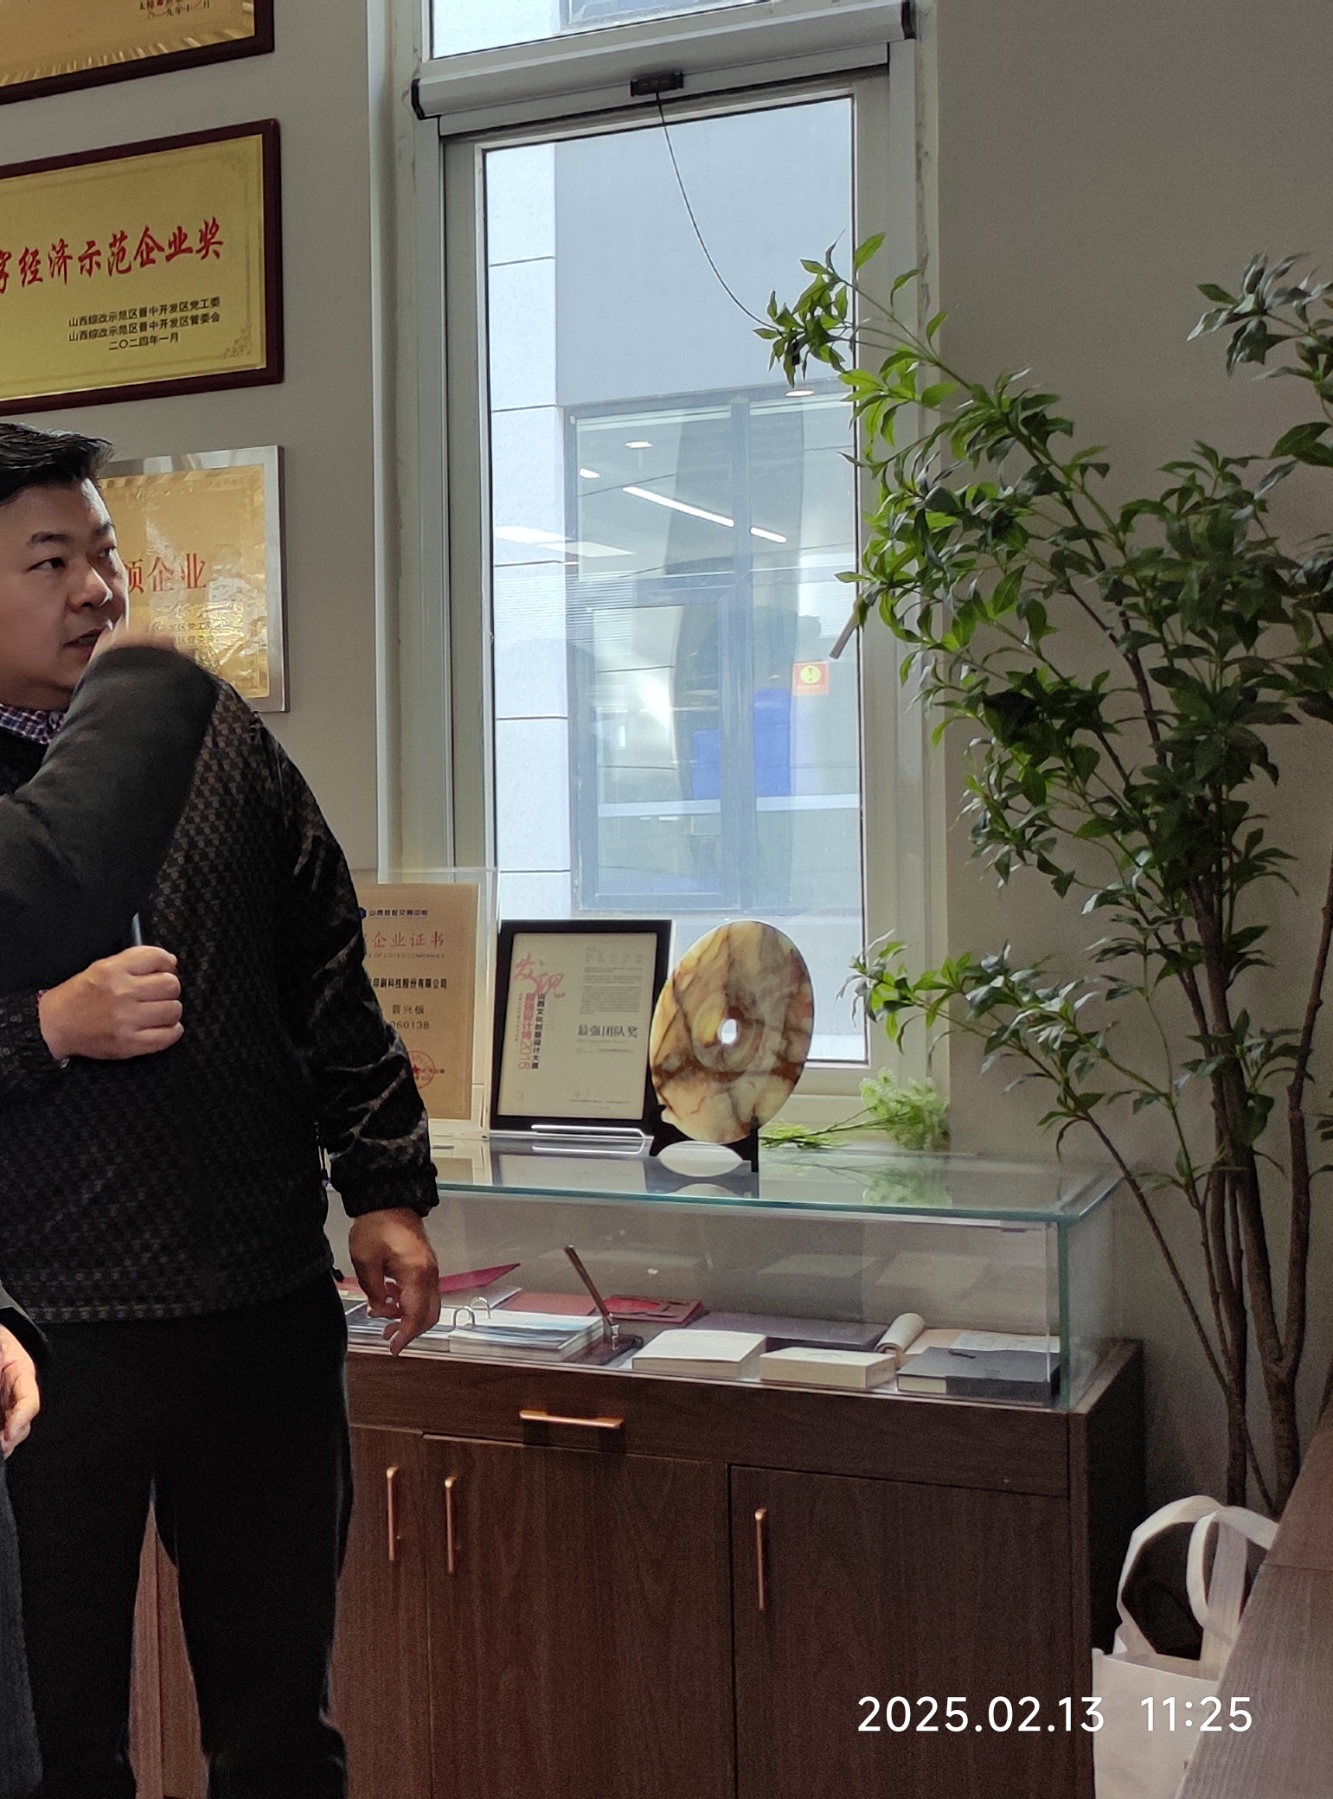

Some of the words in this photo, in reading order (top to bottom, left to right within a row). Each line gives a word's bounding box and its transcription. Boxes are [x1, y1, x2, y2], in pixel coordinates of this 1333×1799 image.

[68, 297, 220, 327] 山西综改示范区晋中开发区党工委
[68, 312, 220, 342] 山西综改示范区晋中开发区管委会
[365, 930, 445, 950] 企业证书
